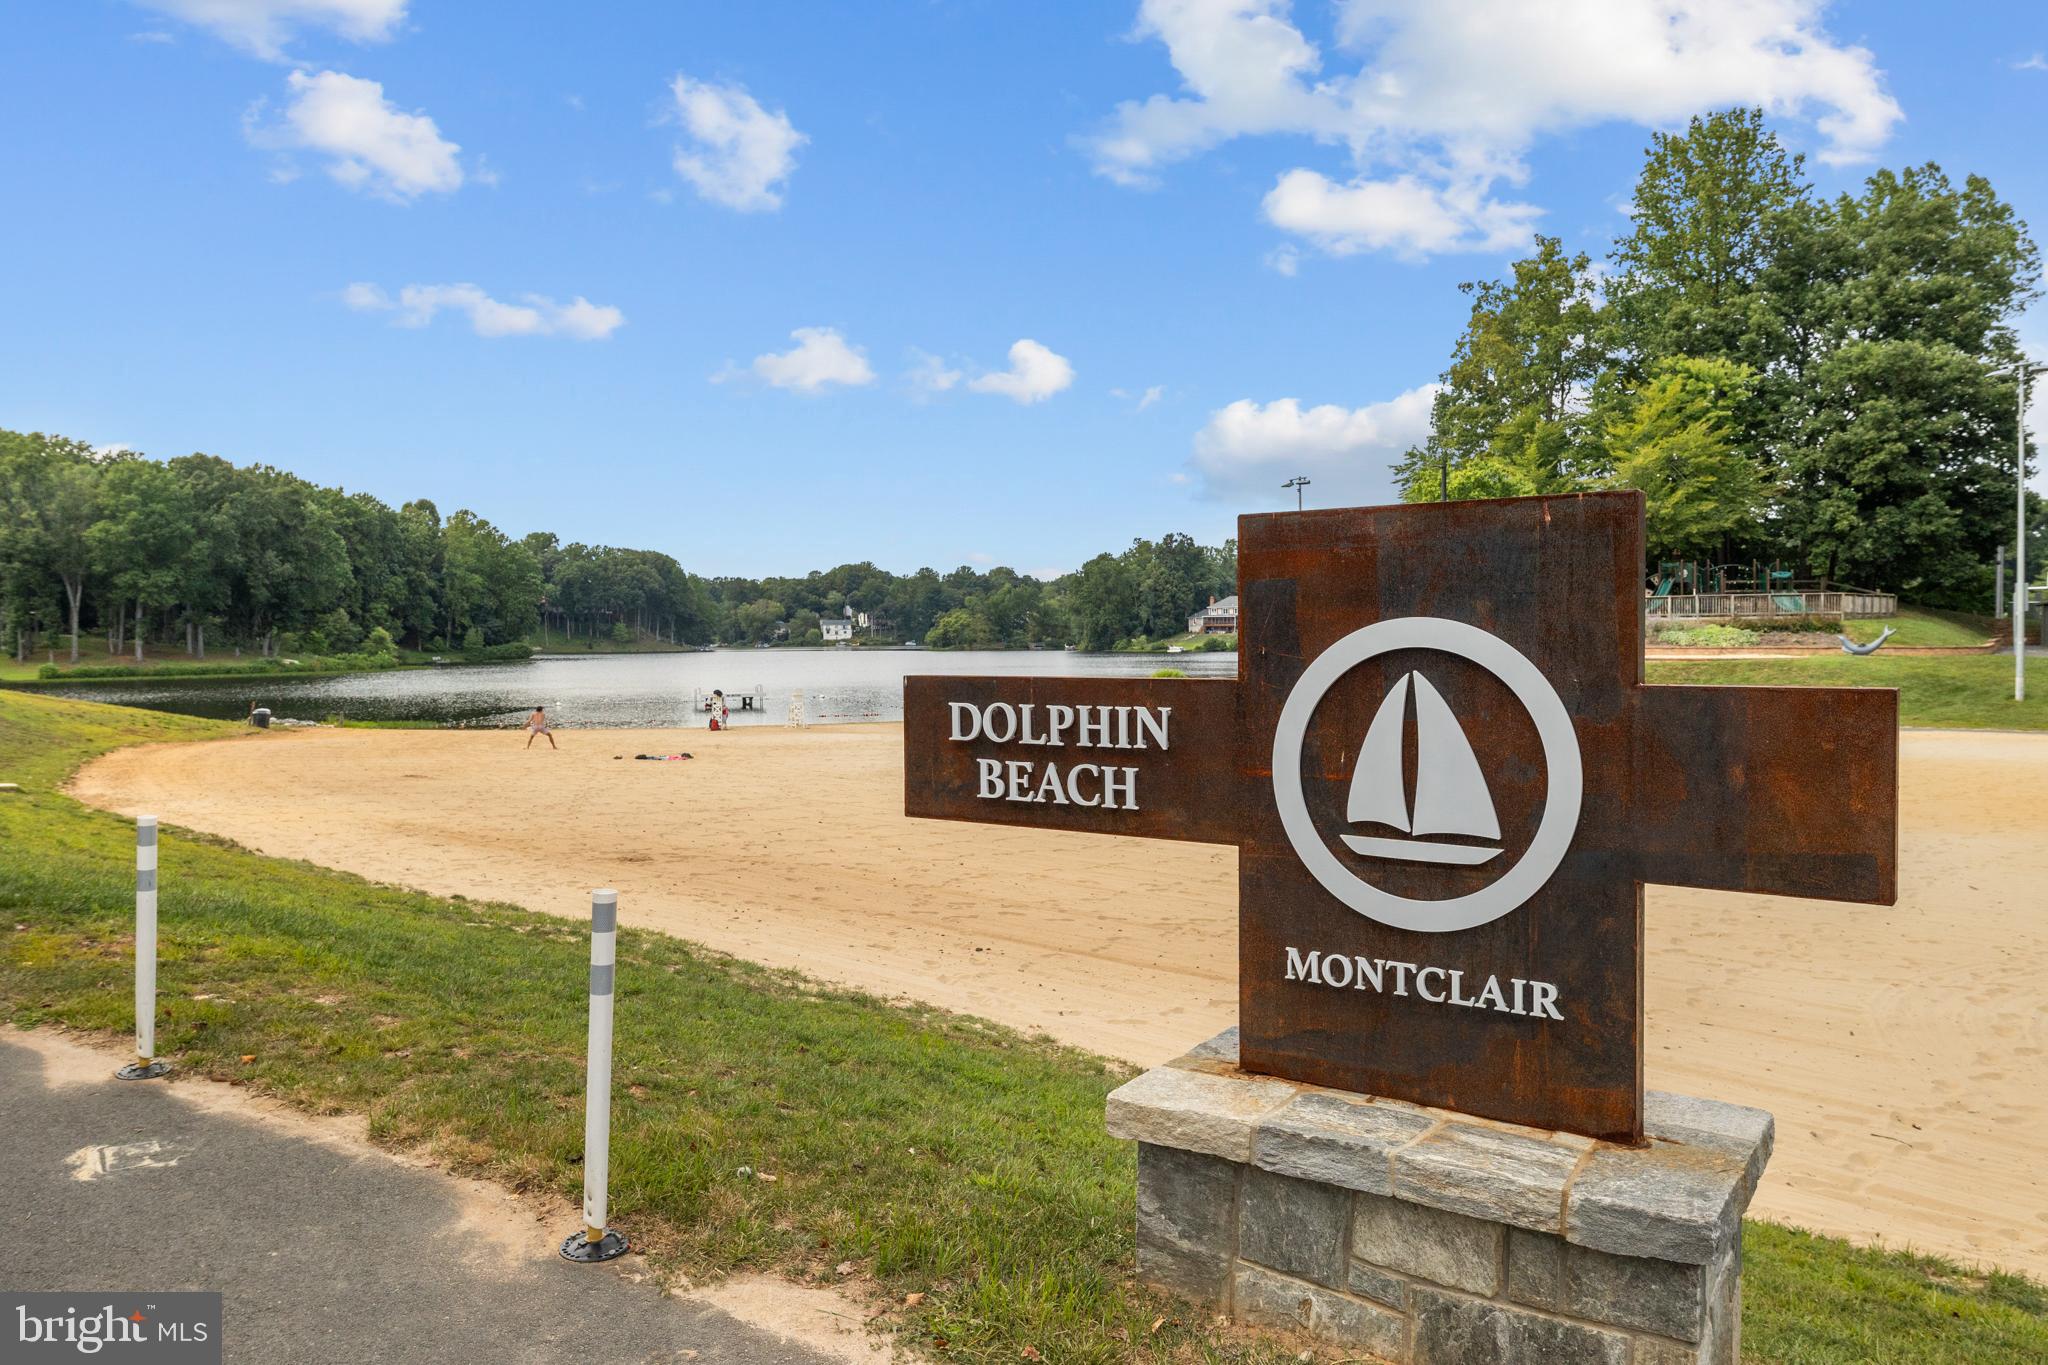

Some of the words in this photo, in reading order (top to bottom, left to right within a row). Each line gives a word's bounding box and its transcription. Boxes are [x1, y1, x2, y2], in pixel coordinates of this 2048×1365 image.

[948, 702, 1172, 750] DOLPHIN
[976, 758, 1140, 810] BEACH
[1284, 946, 1565, 1021] MONTCLAIR
